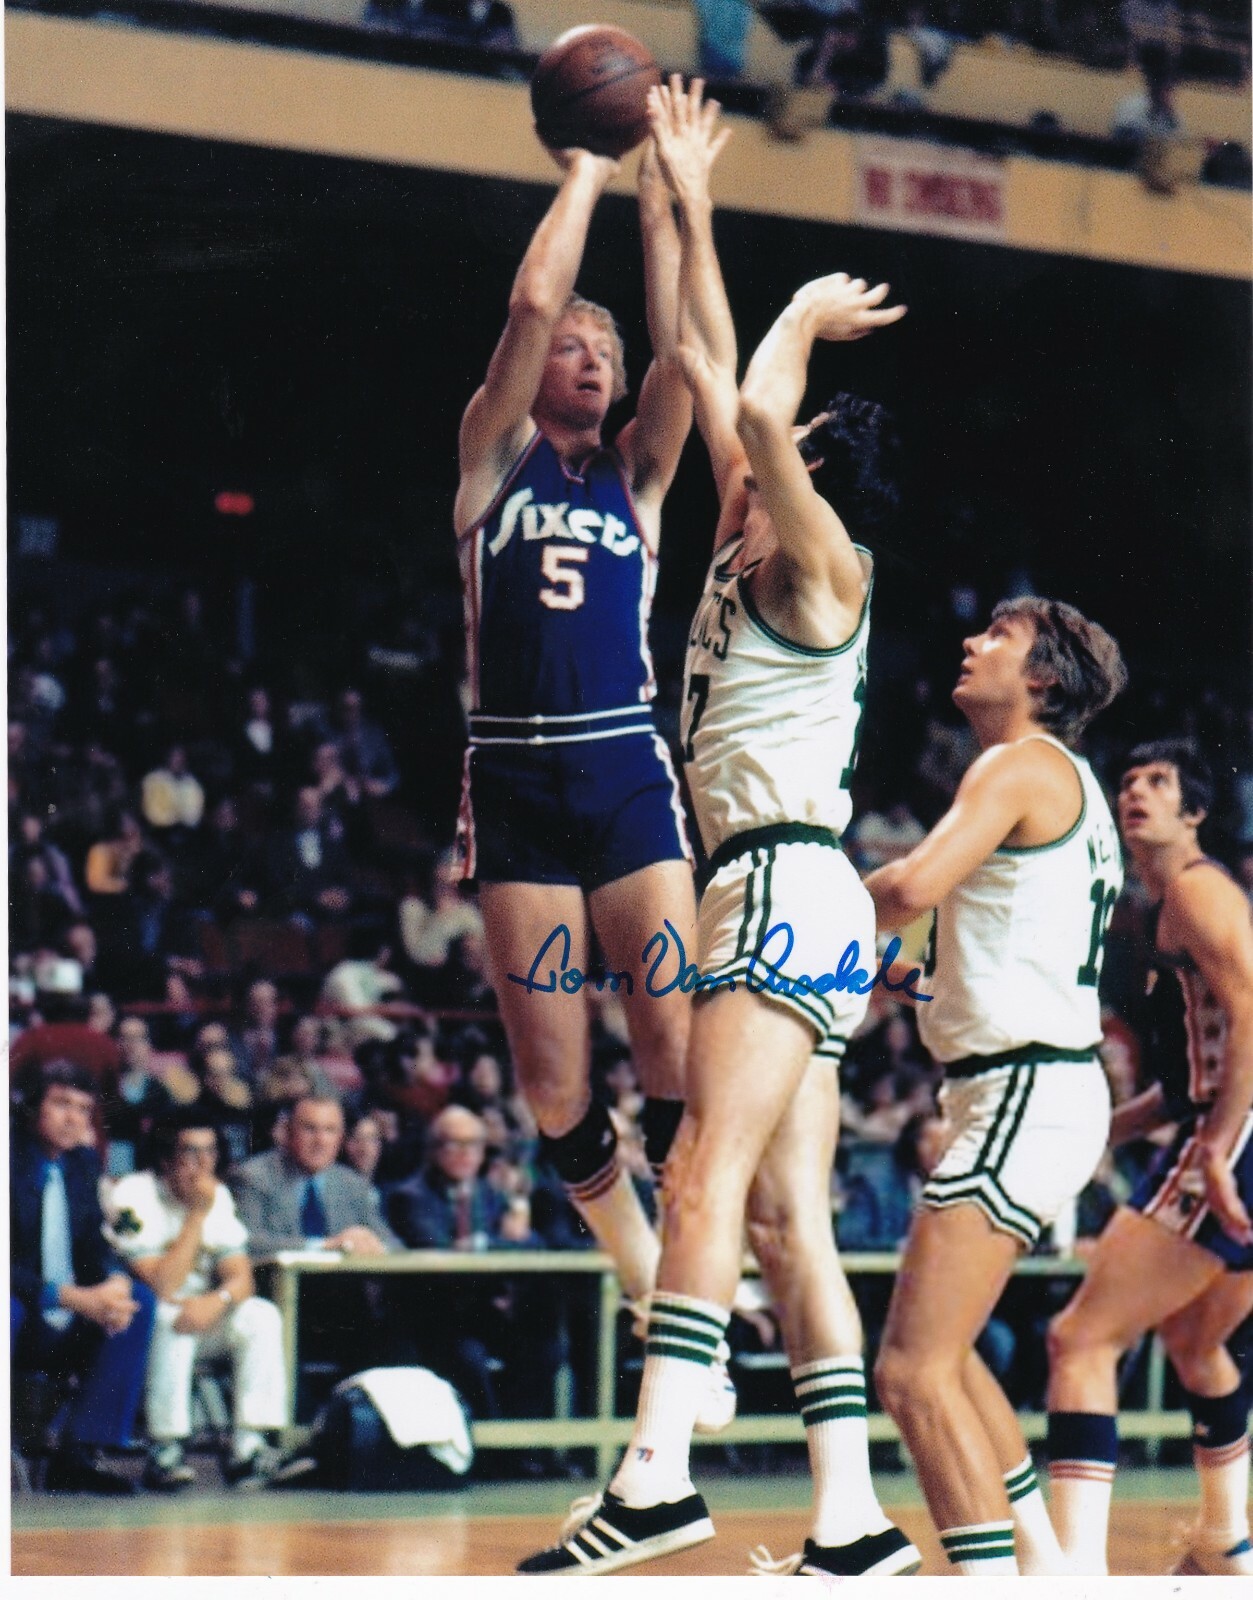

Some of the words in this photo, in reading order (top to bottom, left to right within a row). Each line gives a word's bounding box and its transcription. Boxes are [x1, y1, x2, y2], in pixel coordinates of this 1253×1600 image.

[488, 487, 641, 557] Sixers
[538, 544, 590, 610] 5
[641, 918, 737, 998] Van
